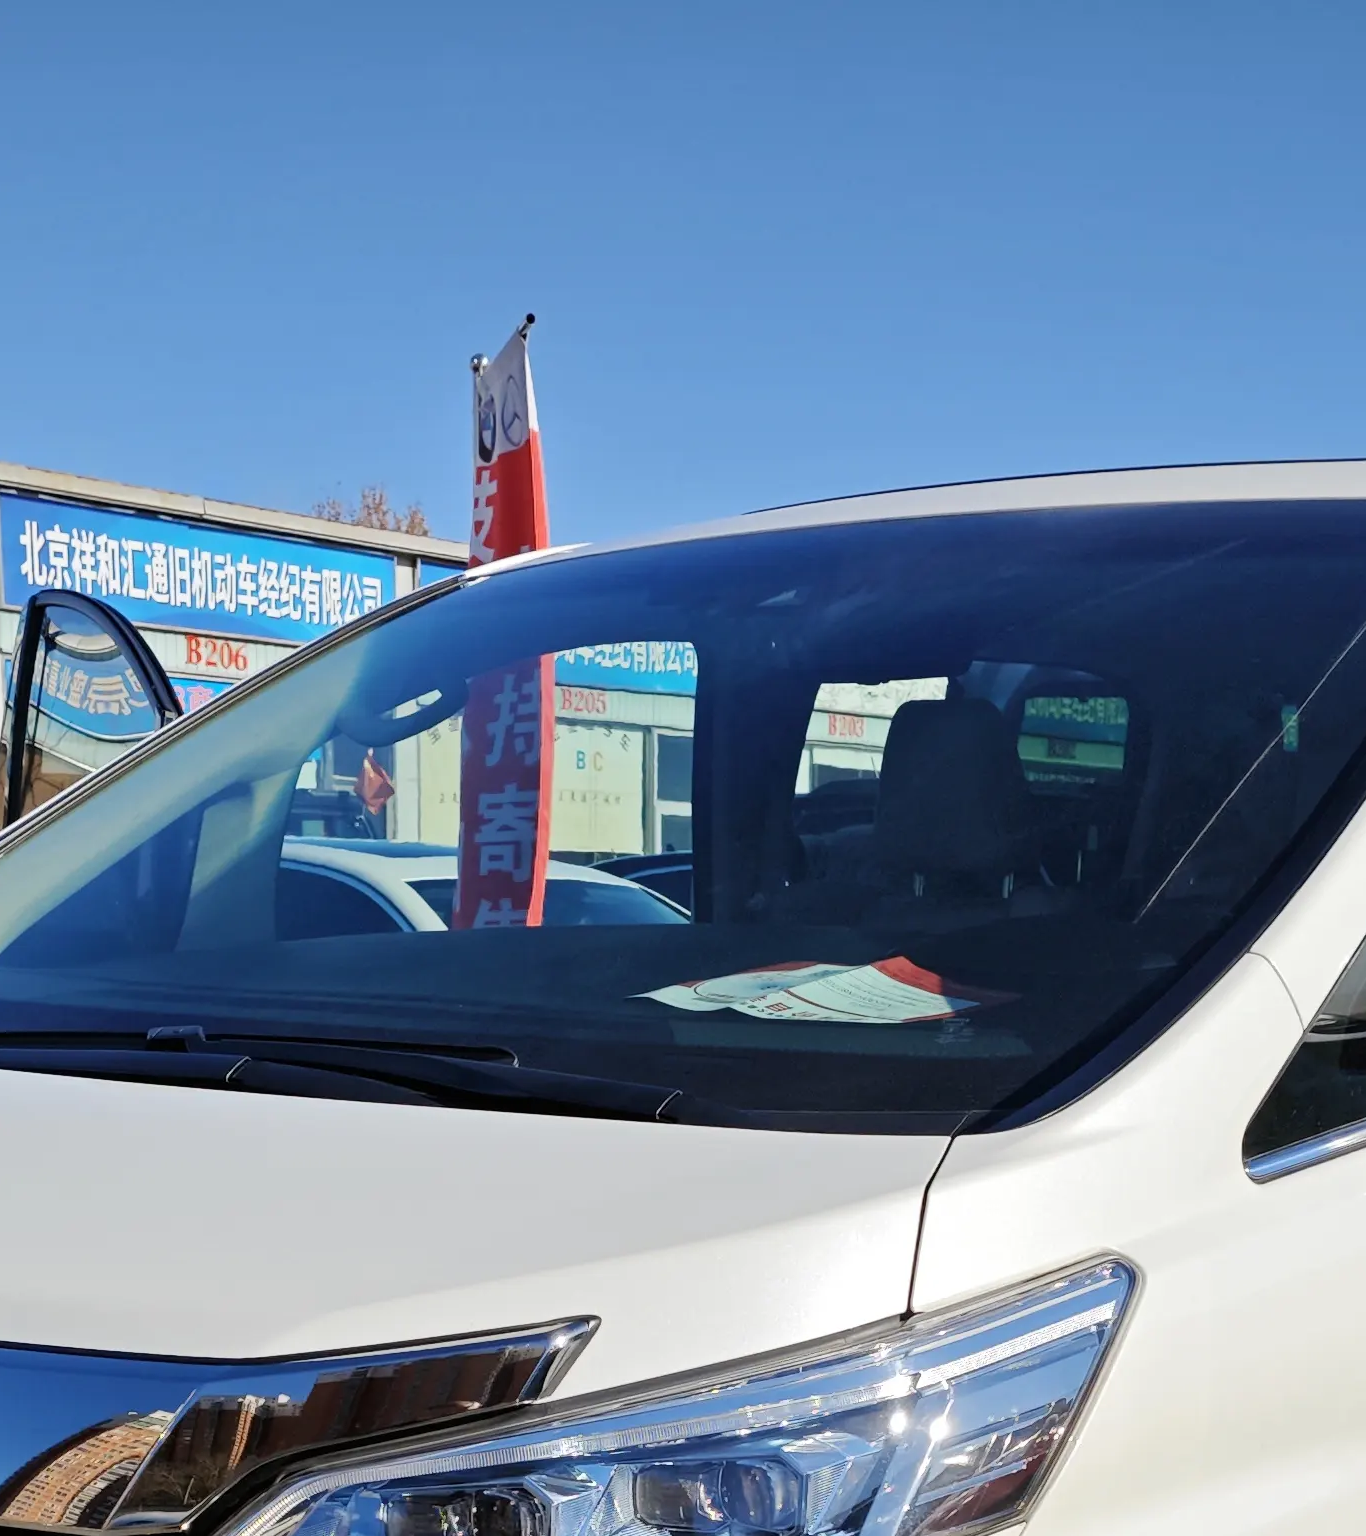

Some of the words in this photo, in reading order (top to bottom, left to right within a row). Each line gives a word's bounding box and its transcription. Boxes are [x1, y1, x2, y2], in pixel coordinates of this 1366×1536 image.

[19, 520, 383, 627] 北京祥和汇通旧机动车经纪有限公司
[185, 634, 248, 671] B206
[561, 687, 607, 714] B205
